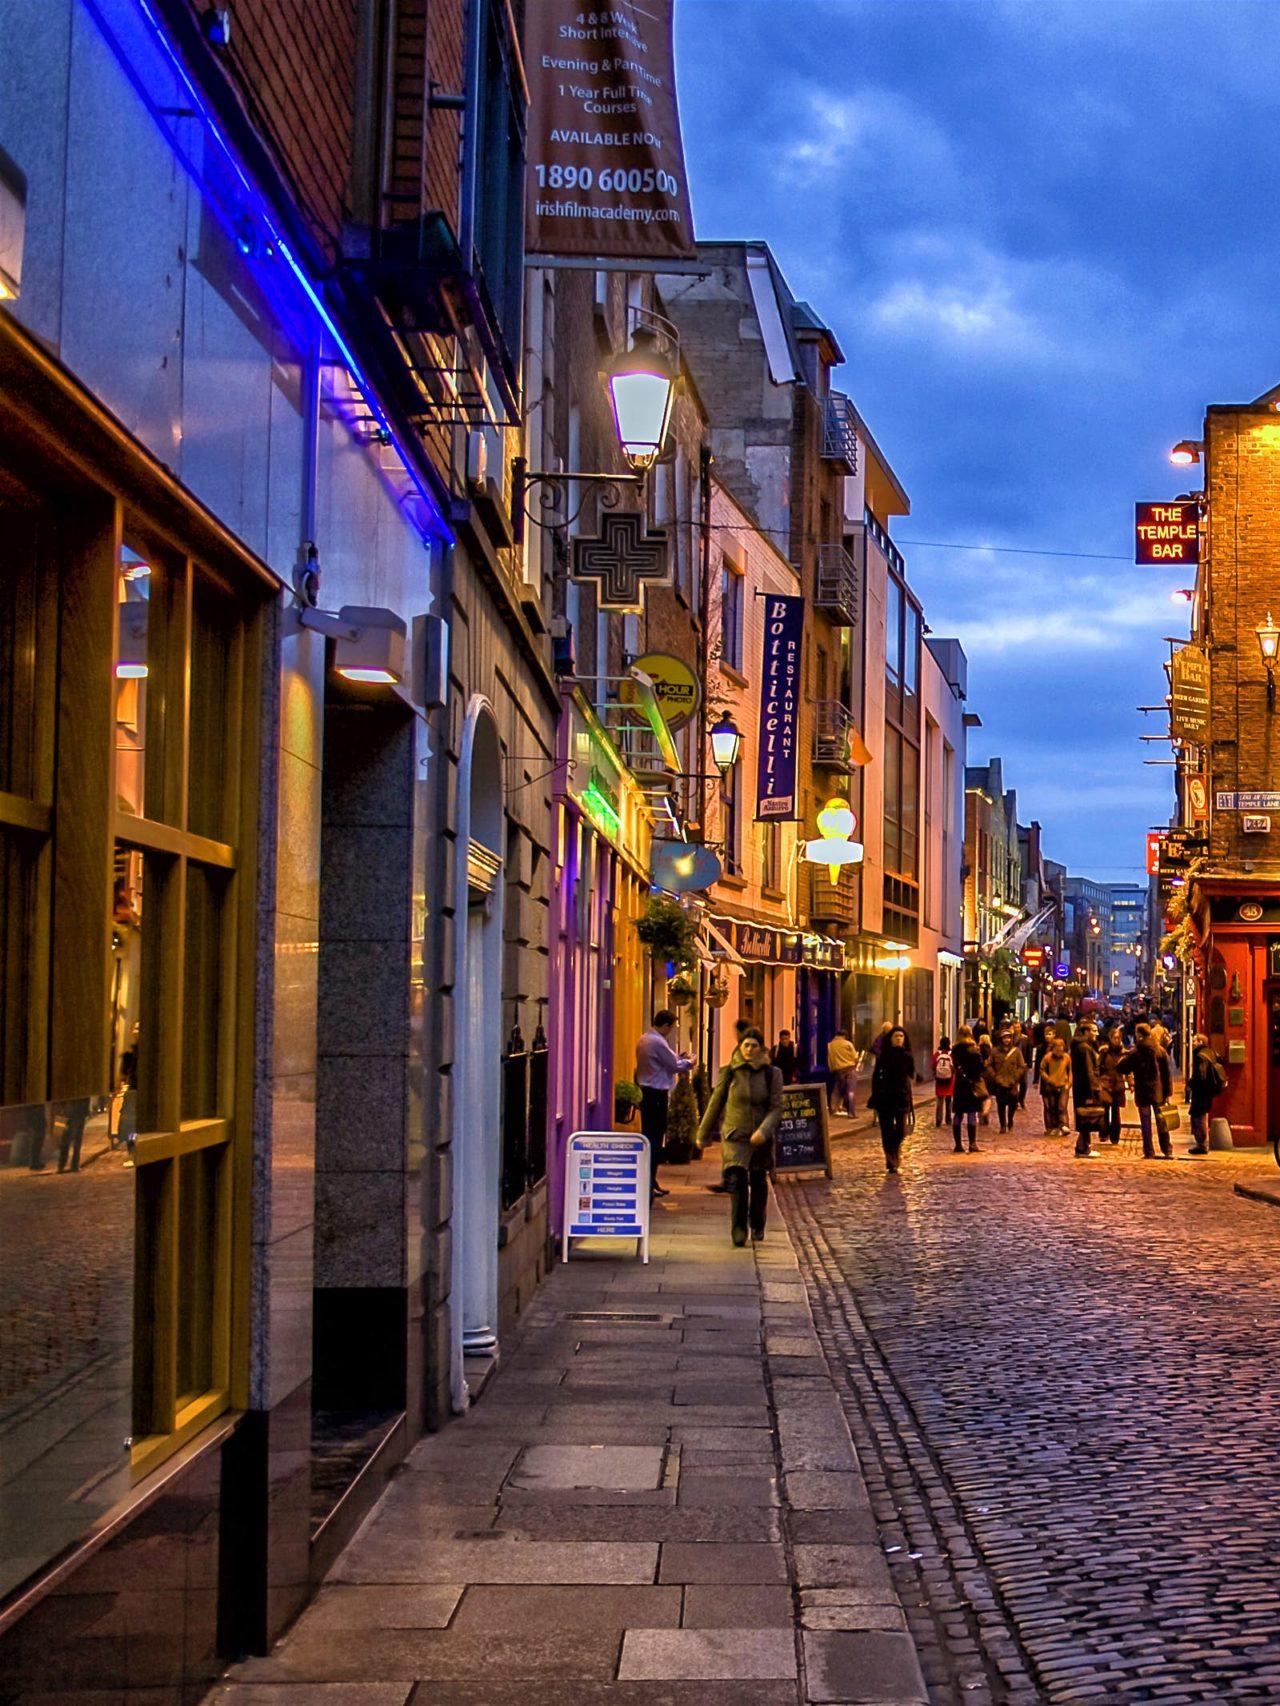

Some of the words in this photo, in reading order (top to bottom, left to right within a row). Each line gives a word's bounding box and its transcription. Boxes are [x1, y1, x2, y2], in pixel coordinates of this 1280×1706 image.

[576, 13, 584, 25] 4
[588, 13, 598, 25] &
[600, 12, 608, 24] 8
[559, 25, 598, 40] Short
[542, 55, 598, 75] Evening
[602, 59, 611, 71] &
[559, 85, 564, 96] 1
[569, 85, 599, 99] Year
[603, 86, 626, 99] Full
[584, 101, 637, 114] Courses
[550, 129, 630, 145] AVAILABLE
[535, 164, 593, 190] 1890
[598, 168, 678, 197] 600500
[535, 201, 680, 224] irishfilmacademy.com
[1151, 507, 1182, 522] THE
[1137, 525, 1197, 539] TEMPLE
[1152, 544, 1183, 558] BAR
[659, 685, 690, 694] HOUR
[766, 602, 787, 795] Botticelli
[783, 641, 796, 758] RESTAURANT
